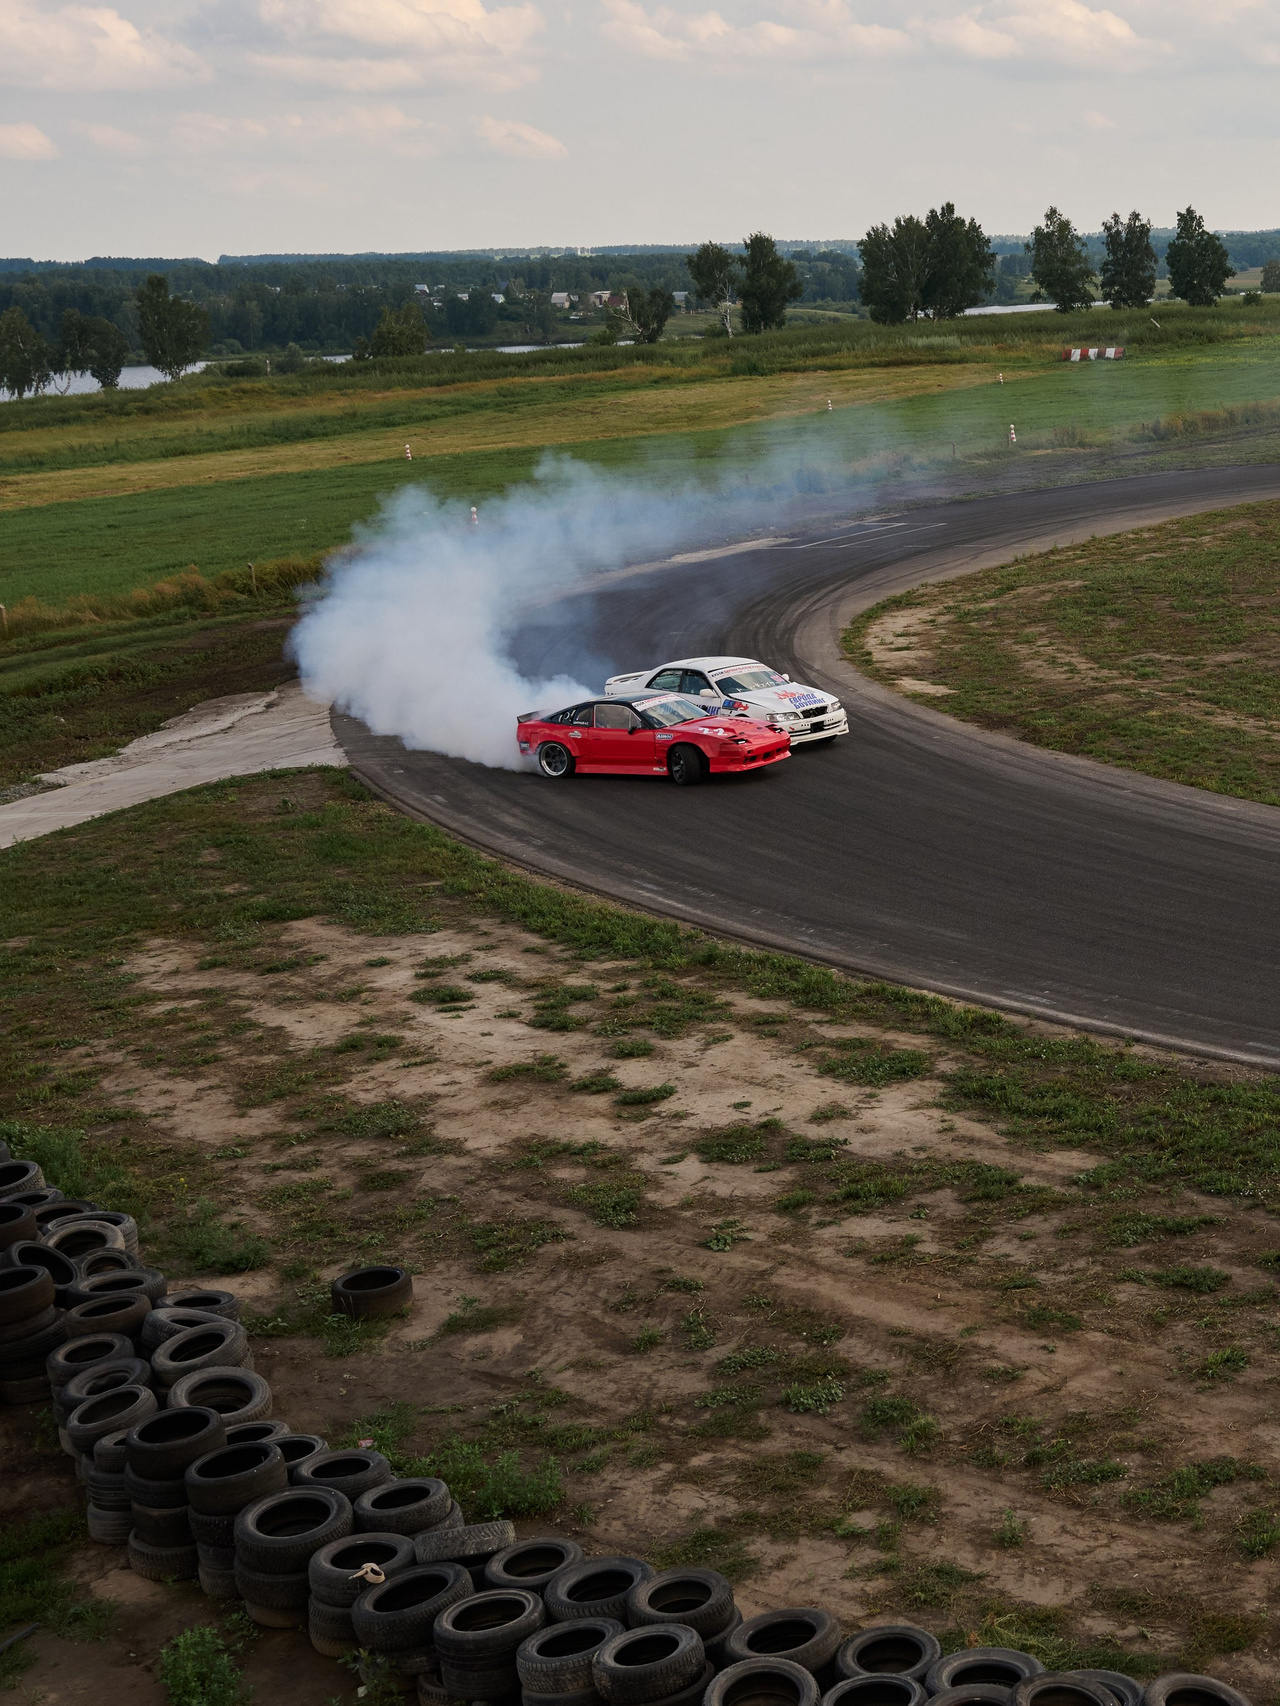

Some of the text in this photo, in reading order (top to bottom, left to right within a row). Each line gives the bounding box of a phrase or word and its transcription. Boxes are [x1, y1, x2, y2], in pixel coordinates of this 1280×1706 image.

[788, 692, 817, 704] ЕВРОПА
[793, 697, 826, 710] БОУЛИНГ
[698, 727, 728, 736] 22
